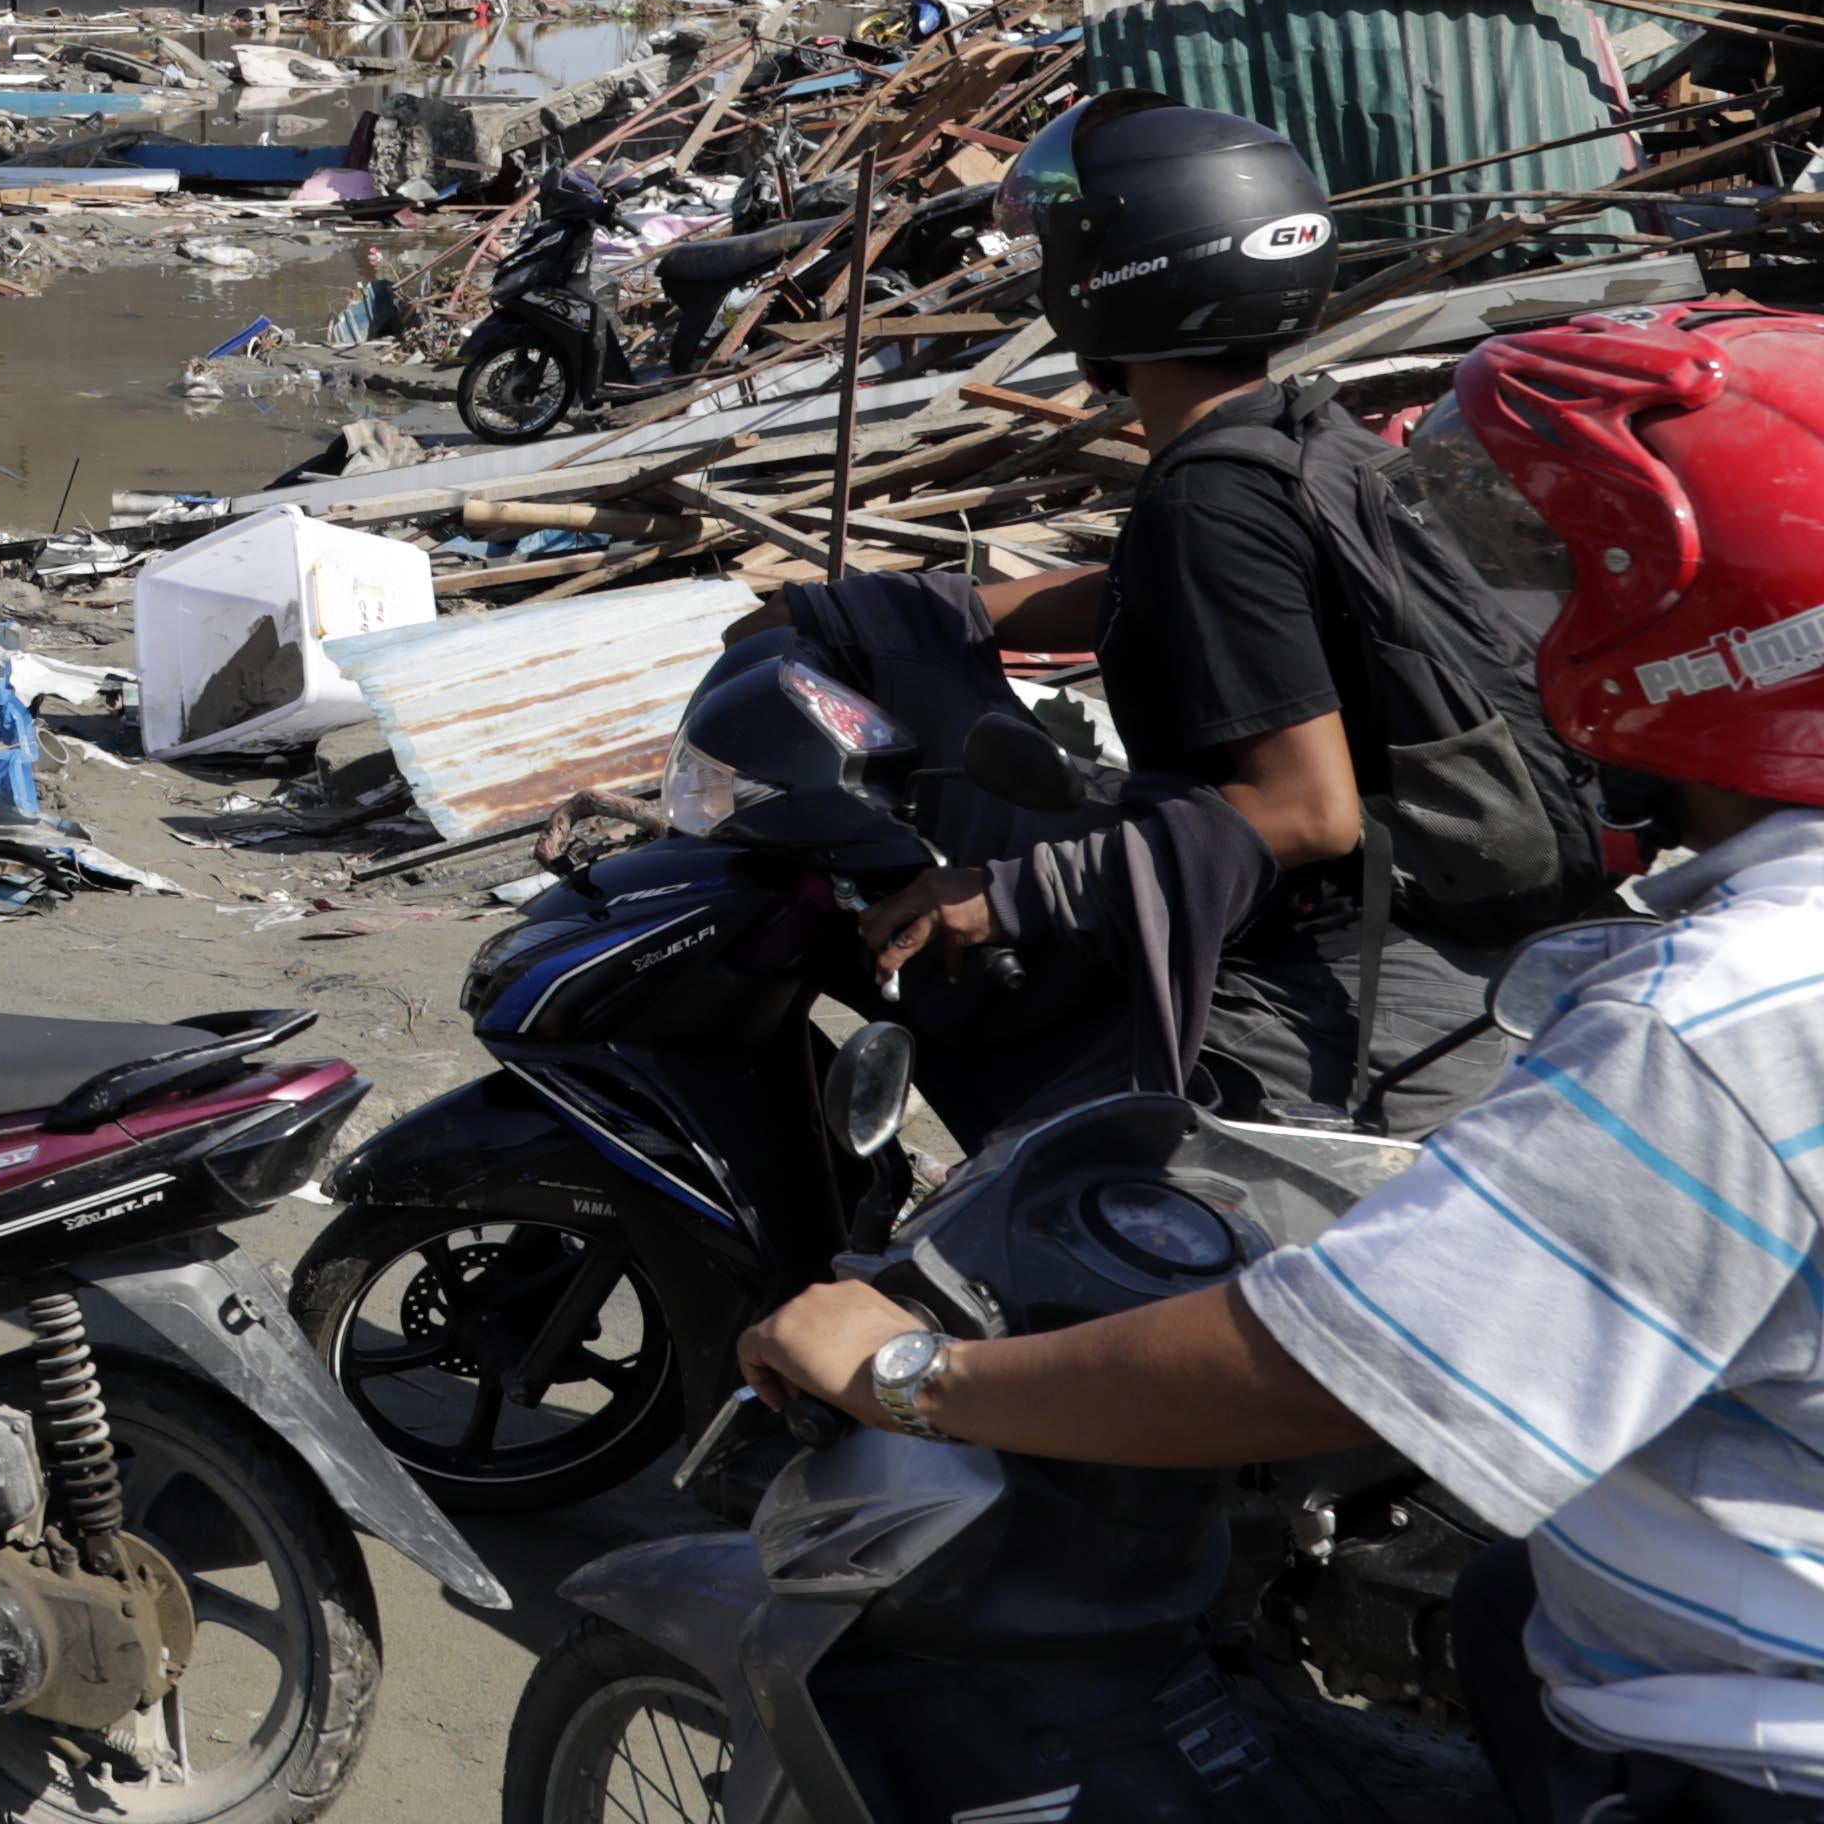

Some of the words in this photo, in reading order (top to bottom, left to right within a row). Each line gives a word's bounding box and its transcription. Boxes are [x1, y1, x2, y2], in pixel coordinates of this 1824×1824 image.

[1269, 225, 1318, 246] GM
[1069, 255, 1169, 297] evolution
[1633, 613, 1824, 705] Platinu
[573, 1199, 616, 1217] YAMA
